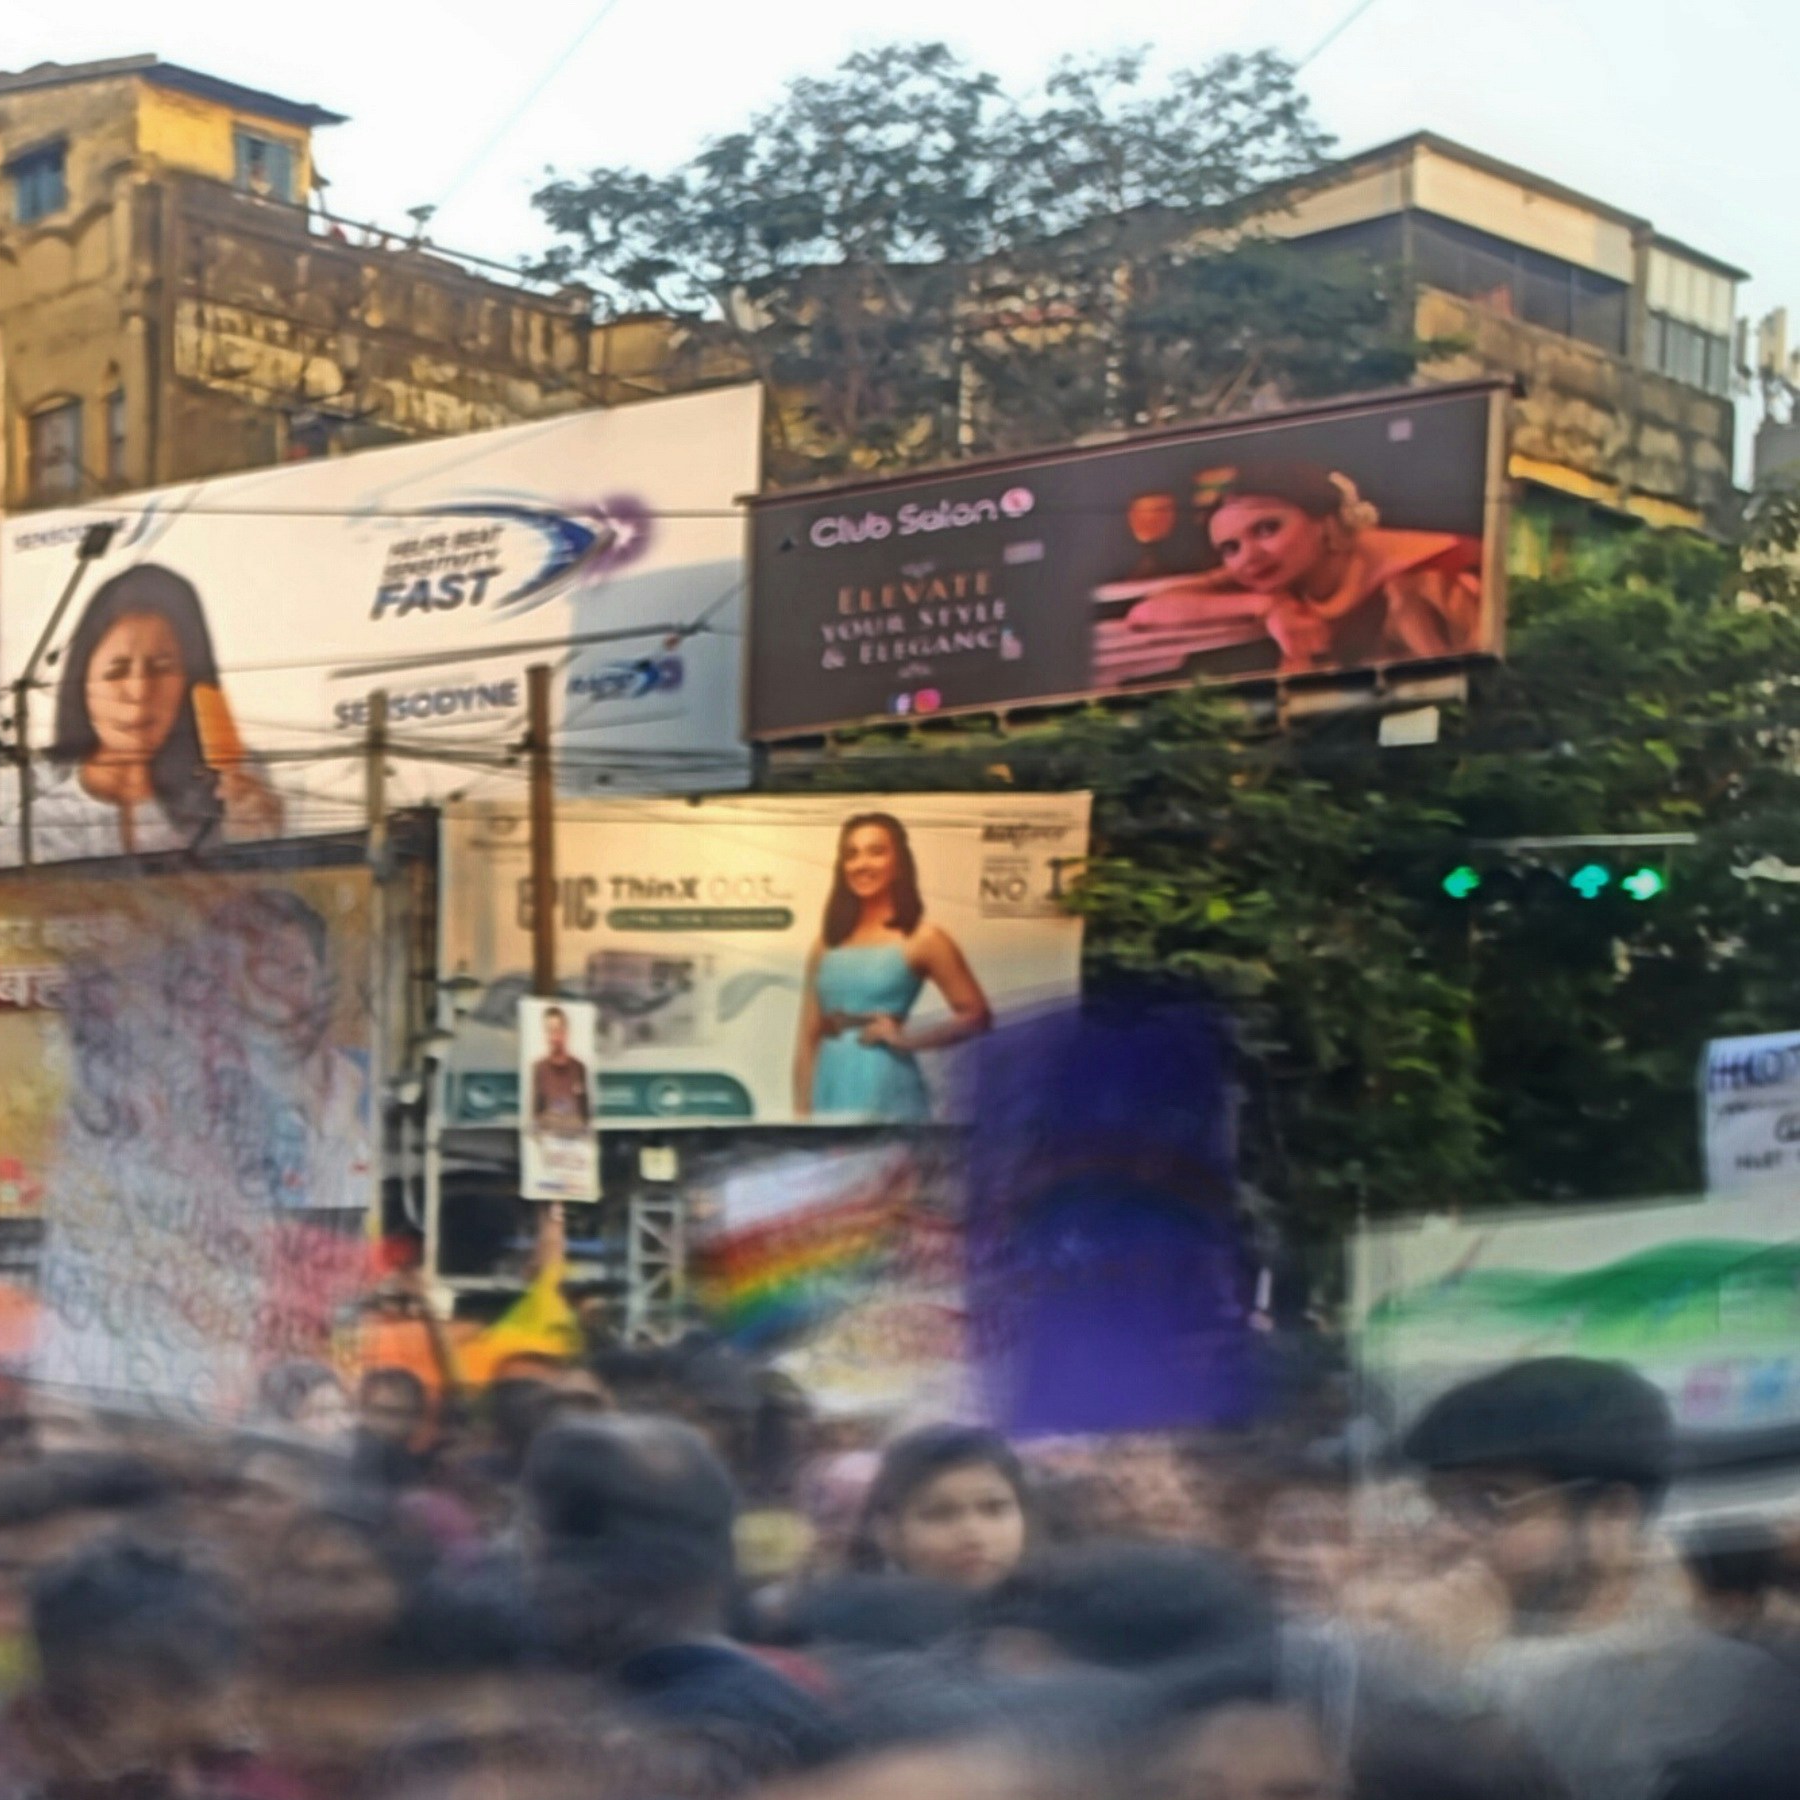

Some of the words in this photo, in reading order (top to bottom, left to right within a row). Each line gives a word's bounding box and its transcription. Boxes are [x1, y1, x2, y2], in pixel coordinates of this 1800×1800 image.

[809, 511, 892, 548] Club
[896, 498, 999, 536] Salon
[368, 564, 504, 622] FAST
[838, 569, 991, 616] ELEVATE
[820, 612, 904, 643] YOUR
[918, 597, 1007, 627] STYLE
[334, 679, 518, 729] SESODYNE
[608, 873, 700, 901] ThinX
